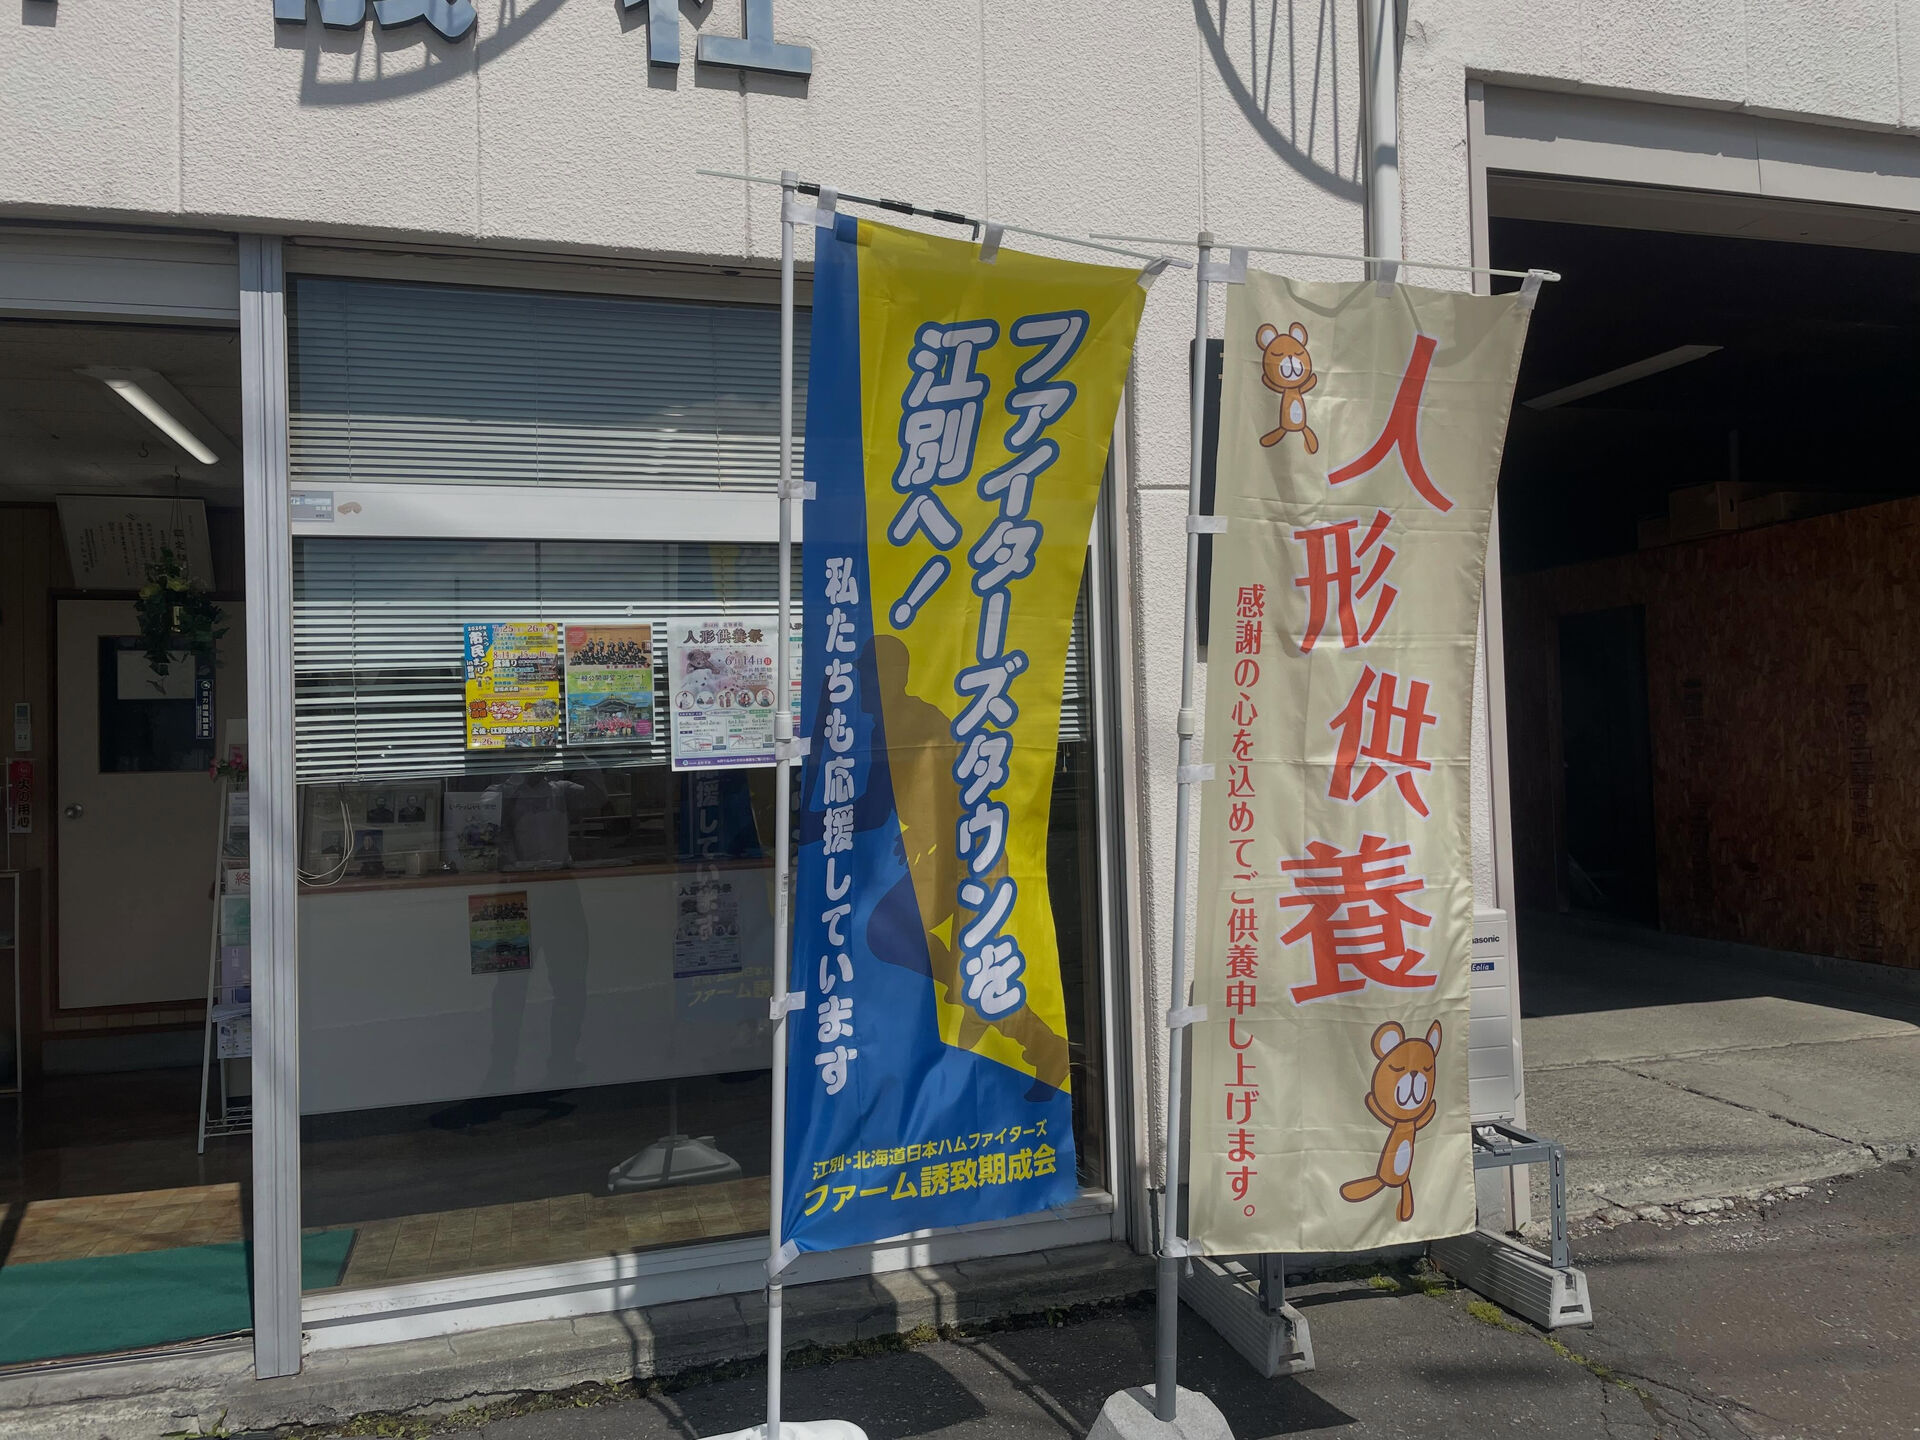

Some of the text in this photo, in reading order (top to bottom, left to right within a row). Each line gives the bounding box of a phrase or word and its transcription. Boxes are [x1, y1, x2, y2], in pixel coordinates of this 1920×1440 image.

[683, 628, 764, 644] 人形供養祭
[954, 309, 1090, 1021] ファイターズタウンを
[1280, 334, 1454, 1006] 人形供養
[814, 556, 859, 1096] 私たちも応援しています
[1225, 584, 1265, 1218] 感謝の心を込めてご供養申し上げます。
[1472, 934, 1500, 944] asonic
[803, 1143, 1057, 1217] ファーム誘致期成会
[813, 1118, 1048, 1180] 江別・北海道日本ハムファイターズ
